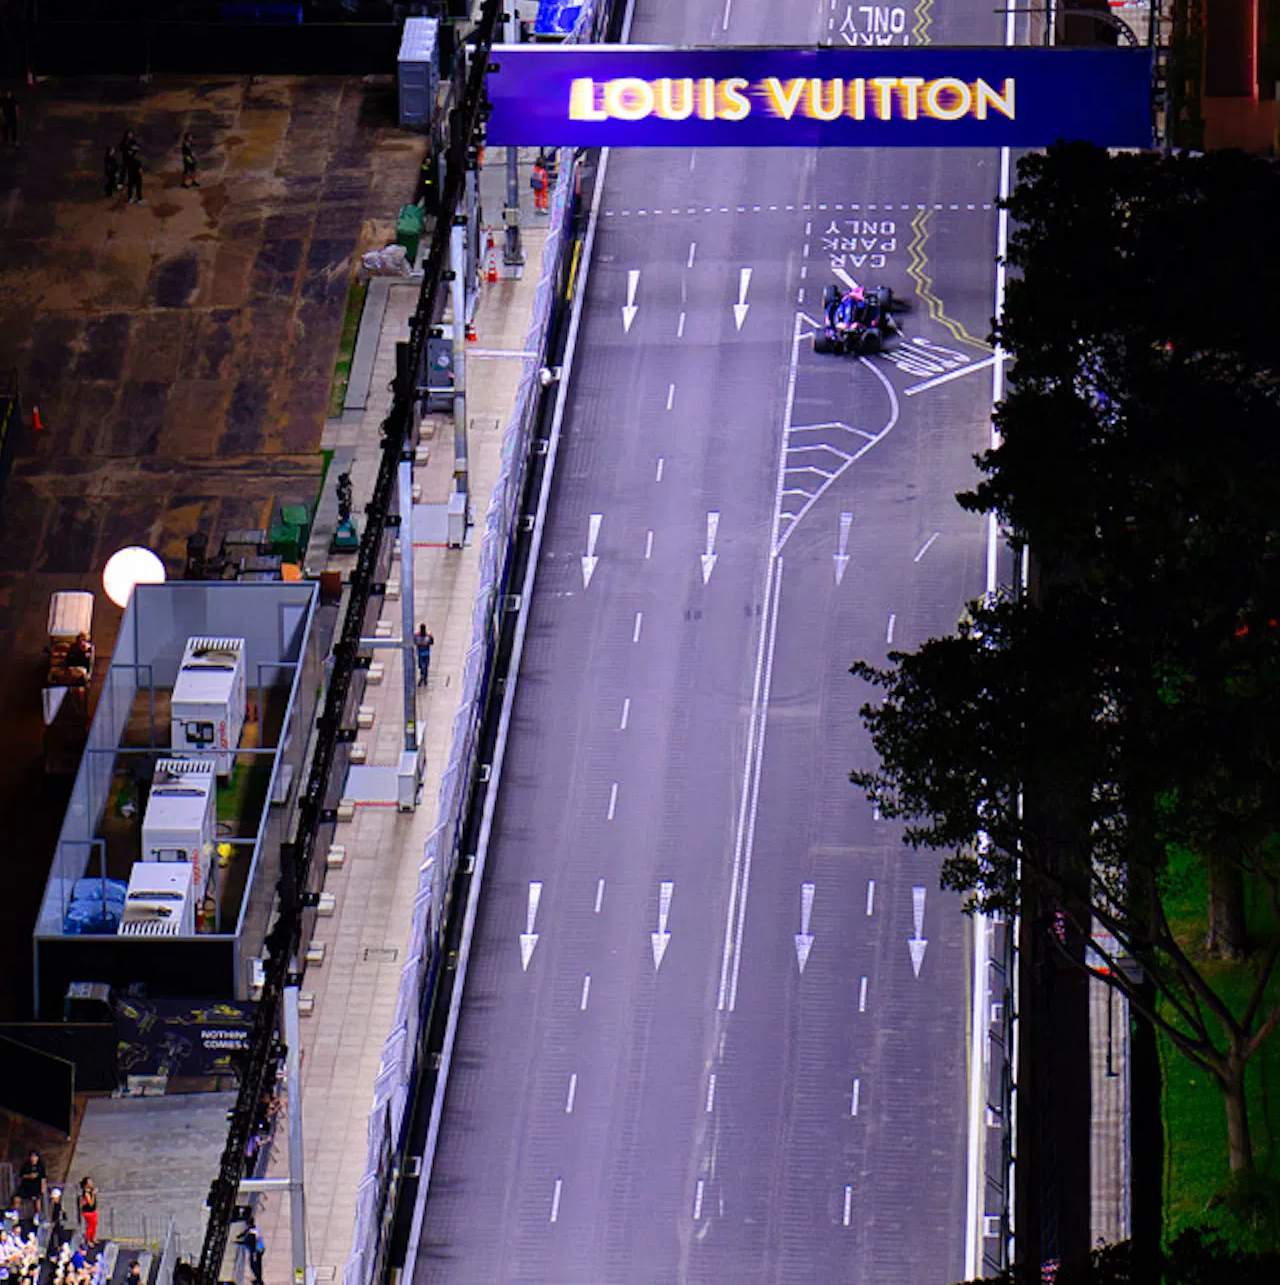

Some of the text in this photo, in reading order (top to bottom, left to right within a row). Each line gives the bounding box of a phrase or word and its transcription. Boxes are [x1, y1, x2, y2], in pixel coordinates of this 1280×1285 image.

[839, 6, 906, 34] ONLY
[569, 77, 1016, 121] LOUIS VUITTON
[825, 220, 896, 235] ONLY
[821, 237, 897, 251] PARK
[830, 253, 886, 268] CAR
[200, 1030, 249, 1040] NOTHIN
